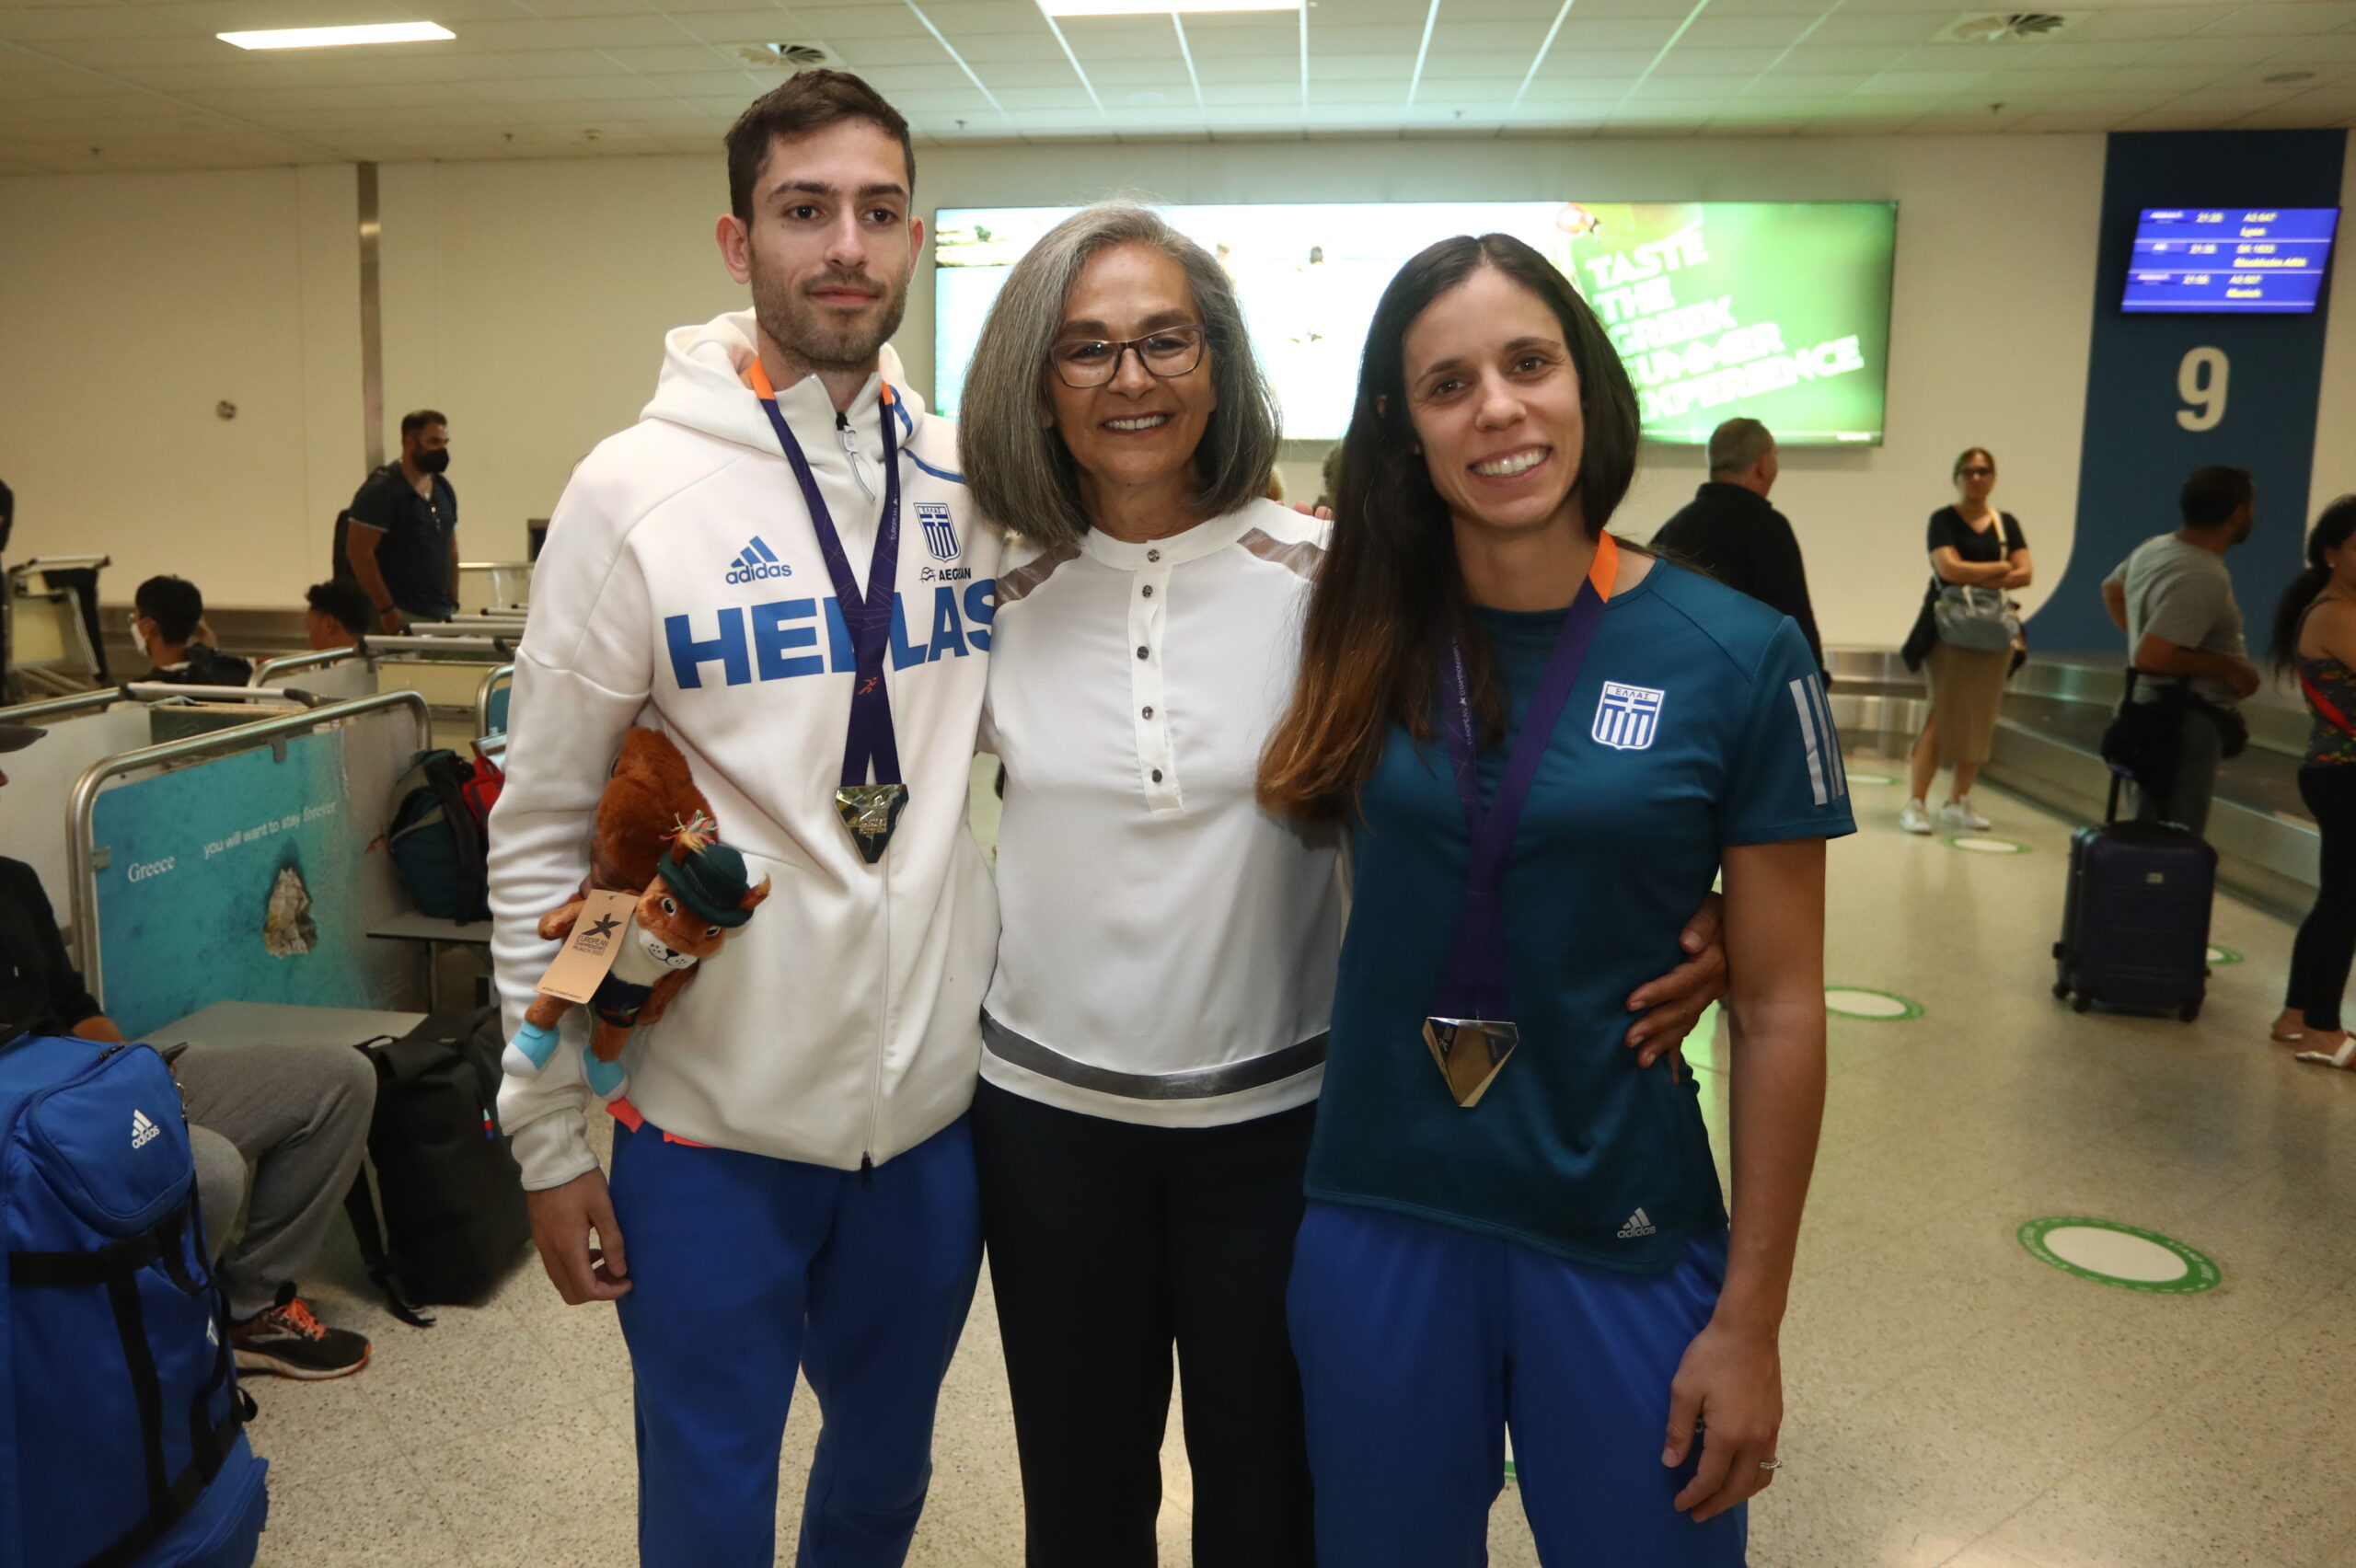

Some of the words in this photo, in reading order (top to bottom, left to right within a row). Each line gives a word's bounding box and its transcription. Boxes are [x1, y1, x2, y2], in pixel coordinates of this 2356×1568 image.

[1585, 229, 1709, 289] TASTE
[1592, 275, 1676, 322] THE
[1608, 295, 1738, 357] GREEK
[1640, 334, 1865, 421] XPERIENCE
[2176, 346, 2230, 432] 9
[725, 562, 792, 584] adidas
[1615, 687, 1649, 700] ΕΛΛΑΣ
[128, 856, 176, 882] Greece
[203, 840, 224, 859] you
[225, 831, 242, 848] will
[243, 824, 268, 842] want
[269, 821, 280, 833] to
[282, 814, 301, 828] stay
[132, 1124, 160, 1149] adidas
[1617, 1226, 1657, 1239] adidas
